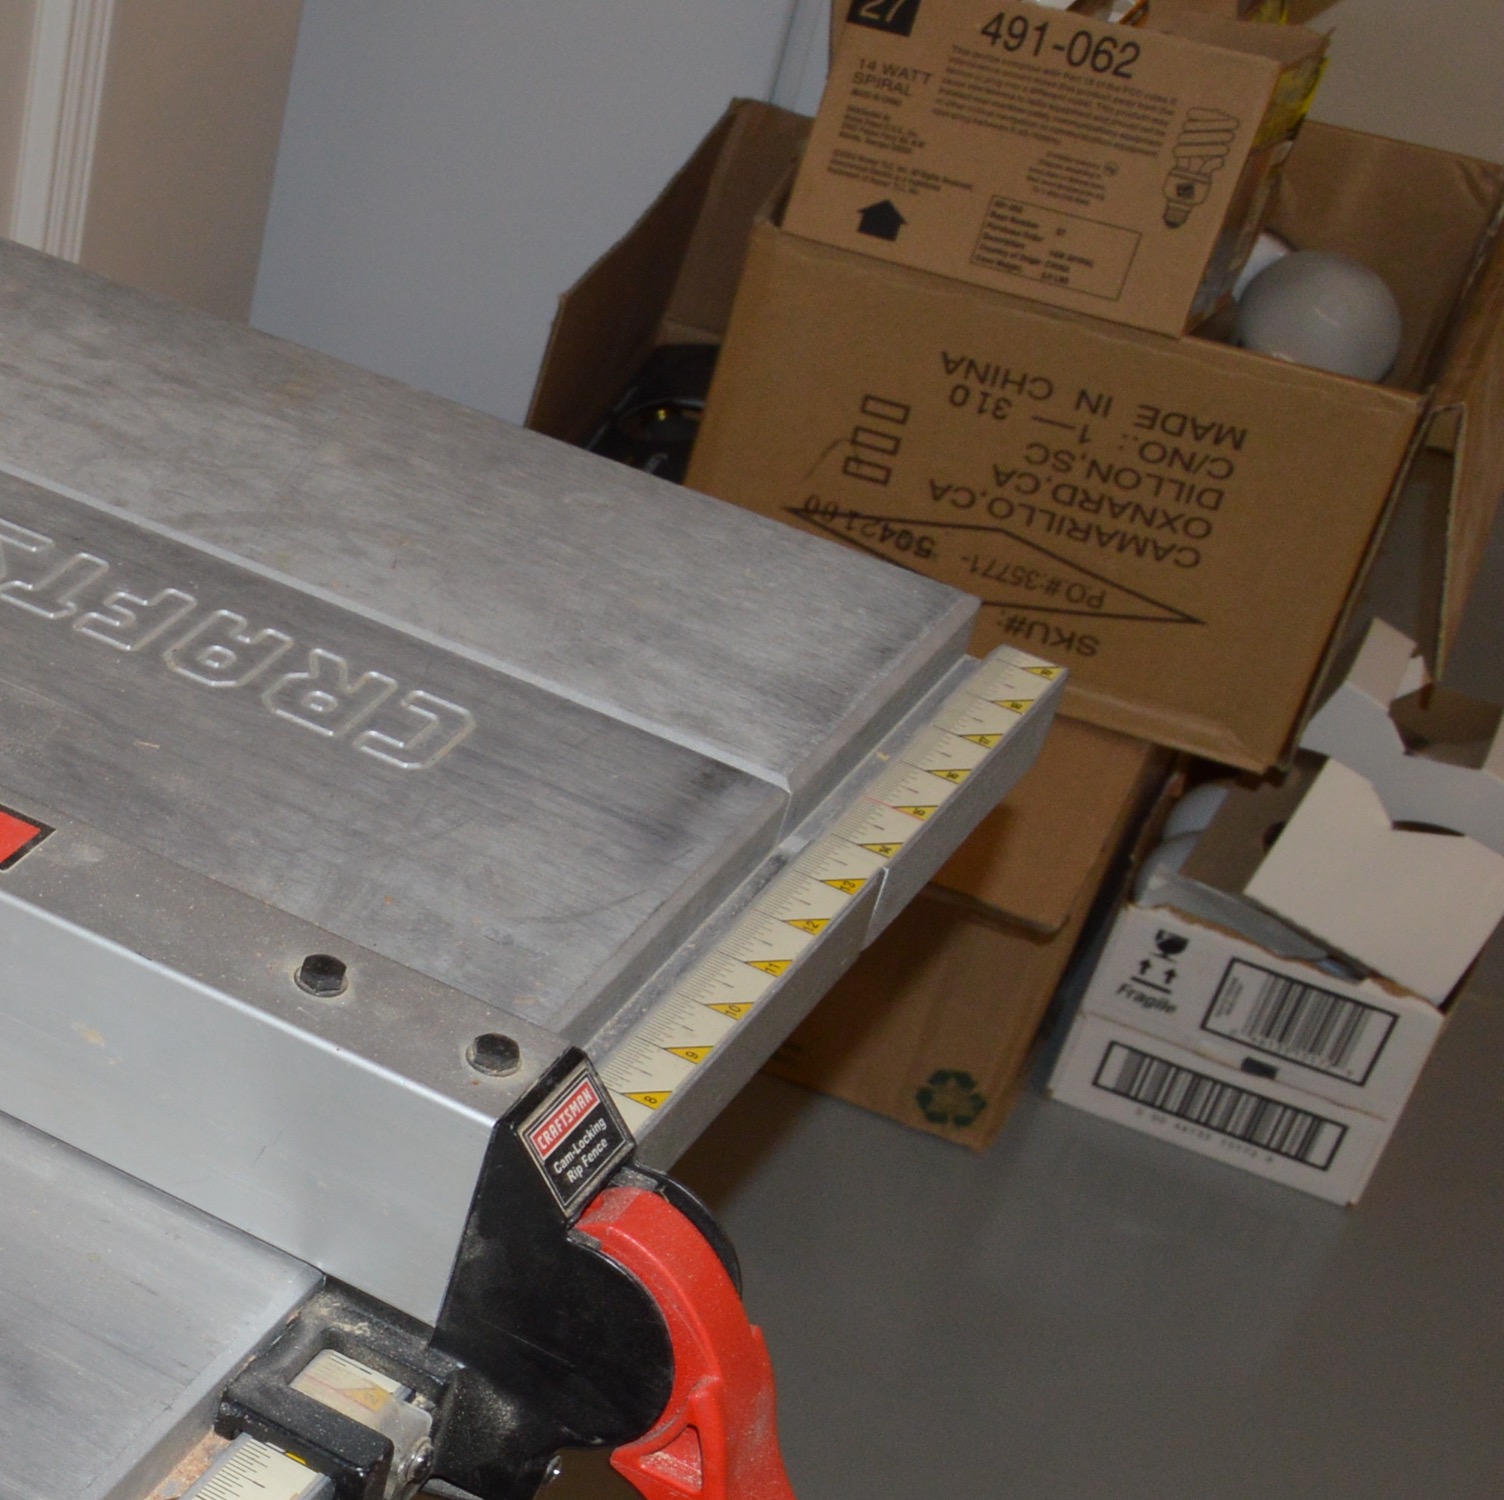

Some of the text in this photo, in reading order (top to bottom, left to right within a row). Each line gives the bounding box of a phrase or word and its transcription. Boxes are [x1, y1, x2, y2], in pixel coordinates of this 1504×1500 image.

[980, 11, 1141, 79] 491-062
[851, 71, 911, 96] SPIRAL
[882, 62, 933, 85] WATT
[942, 351, 1249, 450] MADE IN CHINA
[949, 384, 1013, 421] 310
[840, 880, 857, 892] 13
[802, 919, 819, 932] 12
[764, 962, 781, 974] 11
[725, 1004, 744, 1019] 10
[685, 1049, 700, 1060] 9
[643, 1094, 659, 1106] 8
[537, 1087, 594, 1151] CRAFTSMAN
[552, 1117, 608, 1176] Cam-Locking
[566, 1137, 609, 1184] Rip Fence
